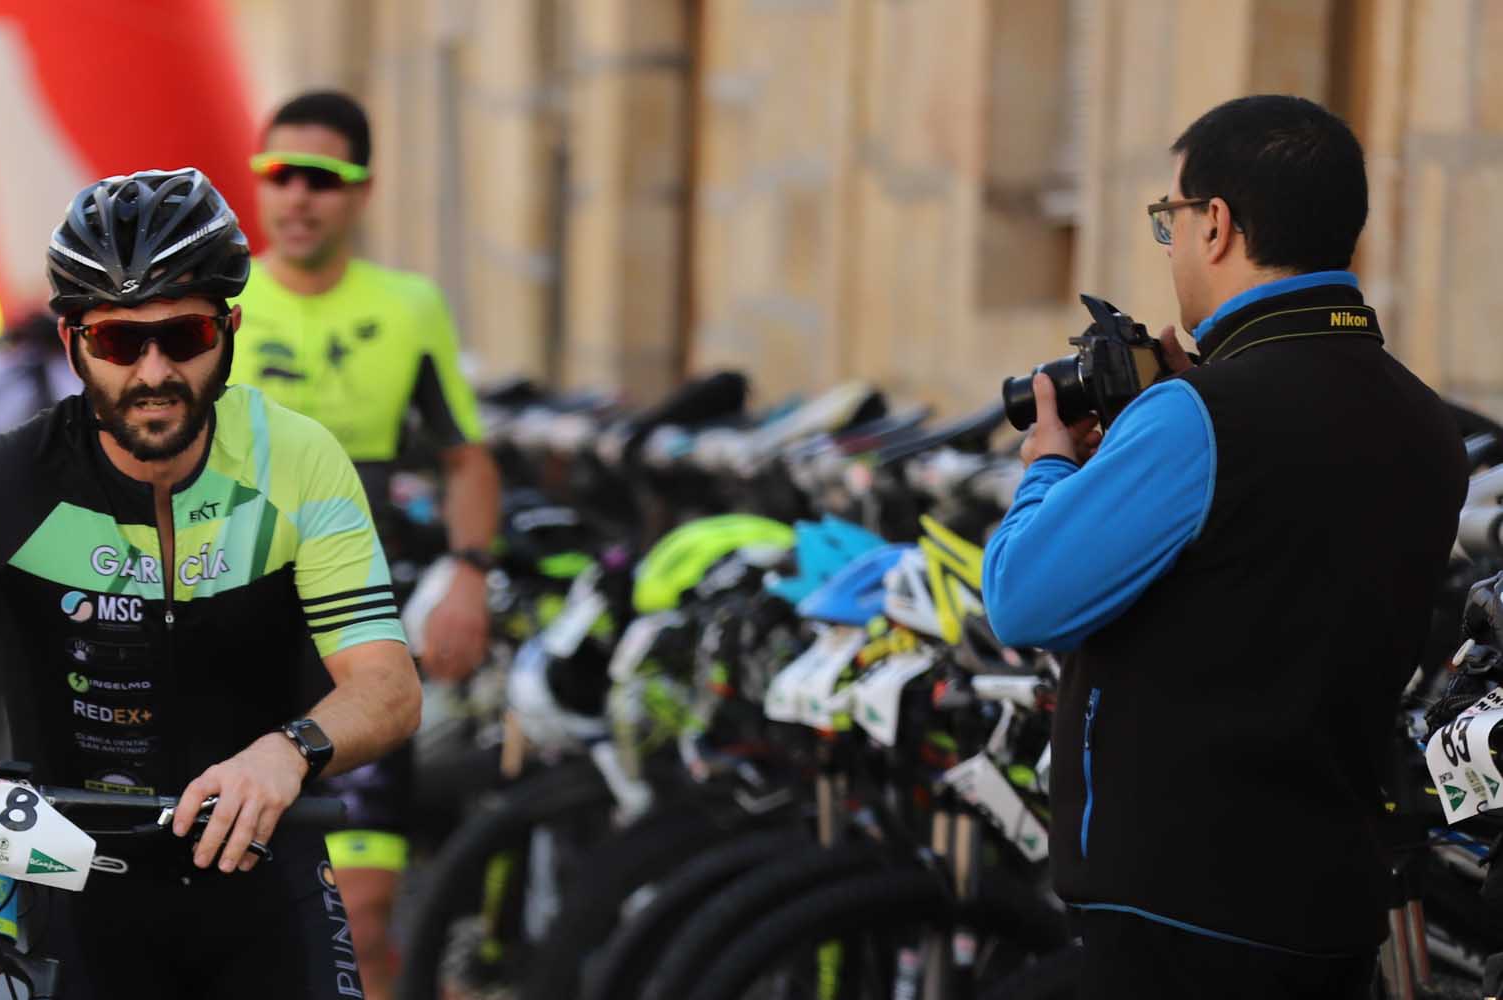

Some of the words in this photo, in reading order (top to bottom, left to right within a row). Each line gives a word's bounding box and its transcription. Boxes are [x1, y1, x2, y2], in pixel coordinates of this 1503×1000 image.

[1330, 311, 1368, 328] Nikon
[97, 595, 143, 622] MSC
[73, 699, 153, 725] REDEX+
